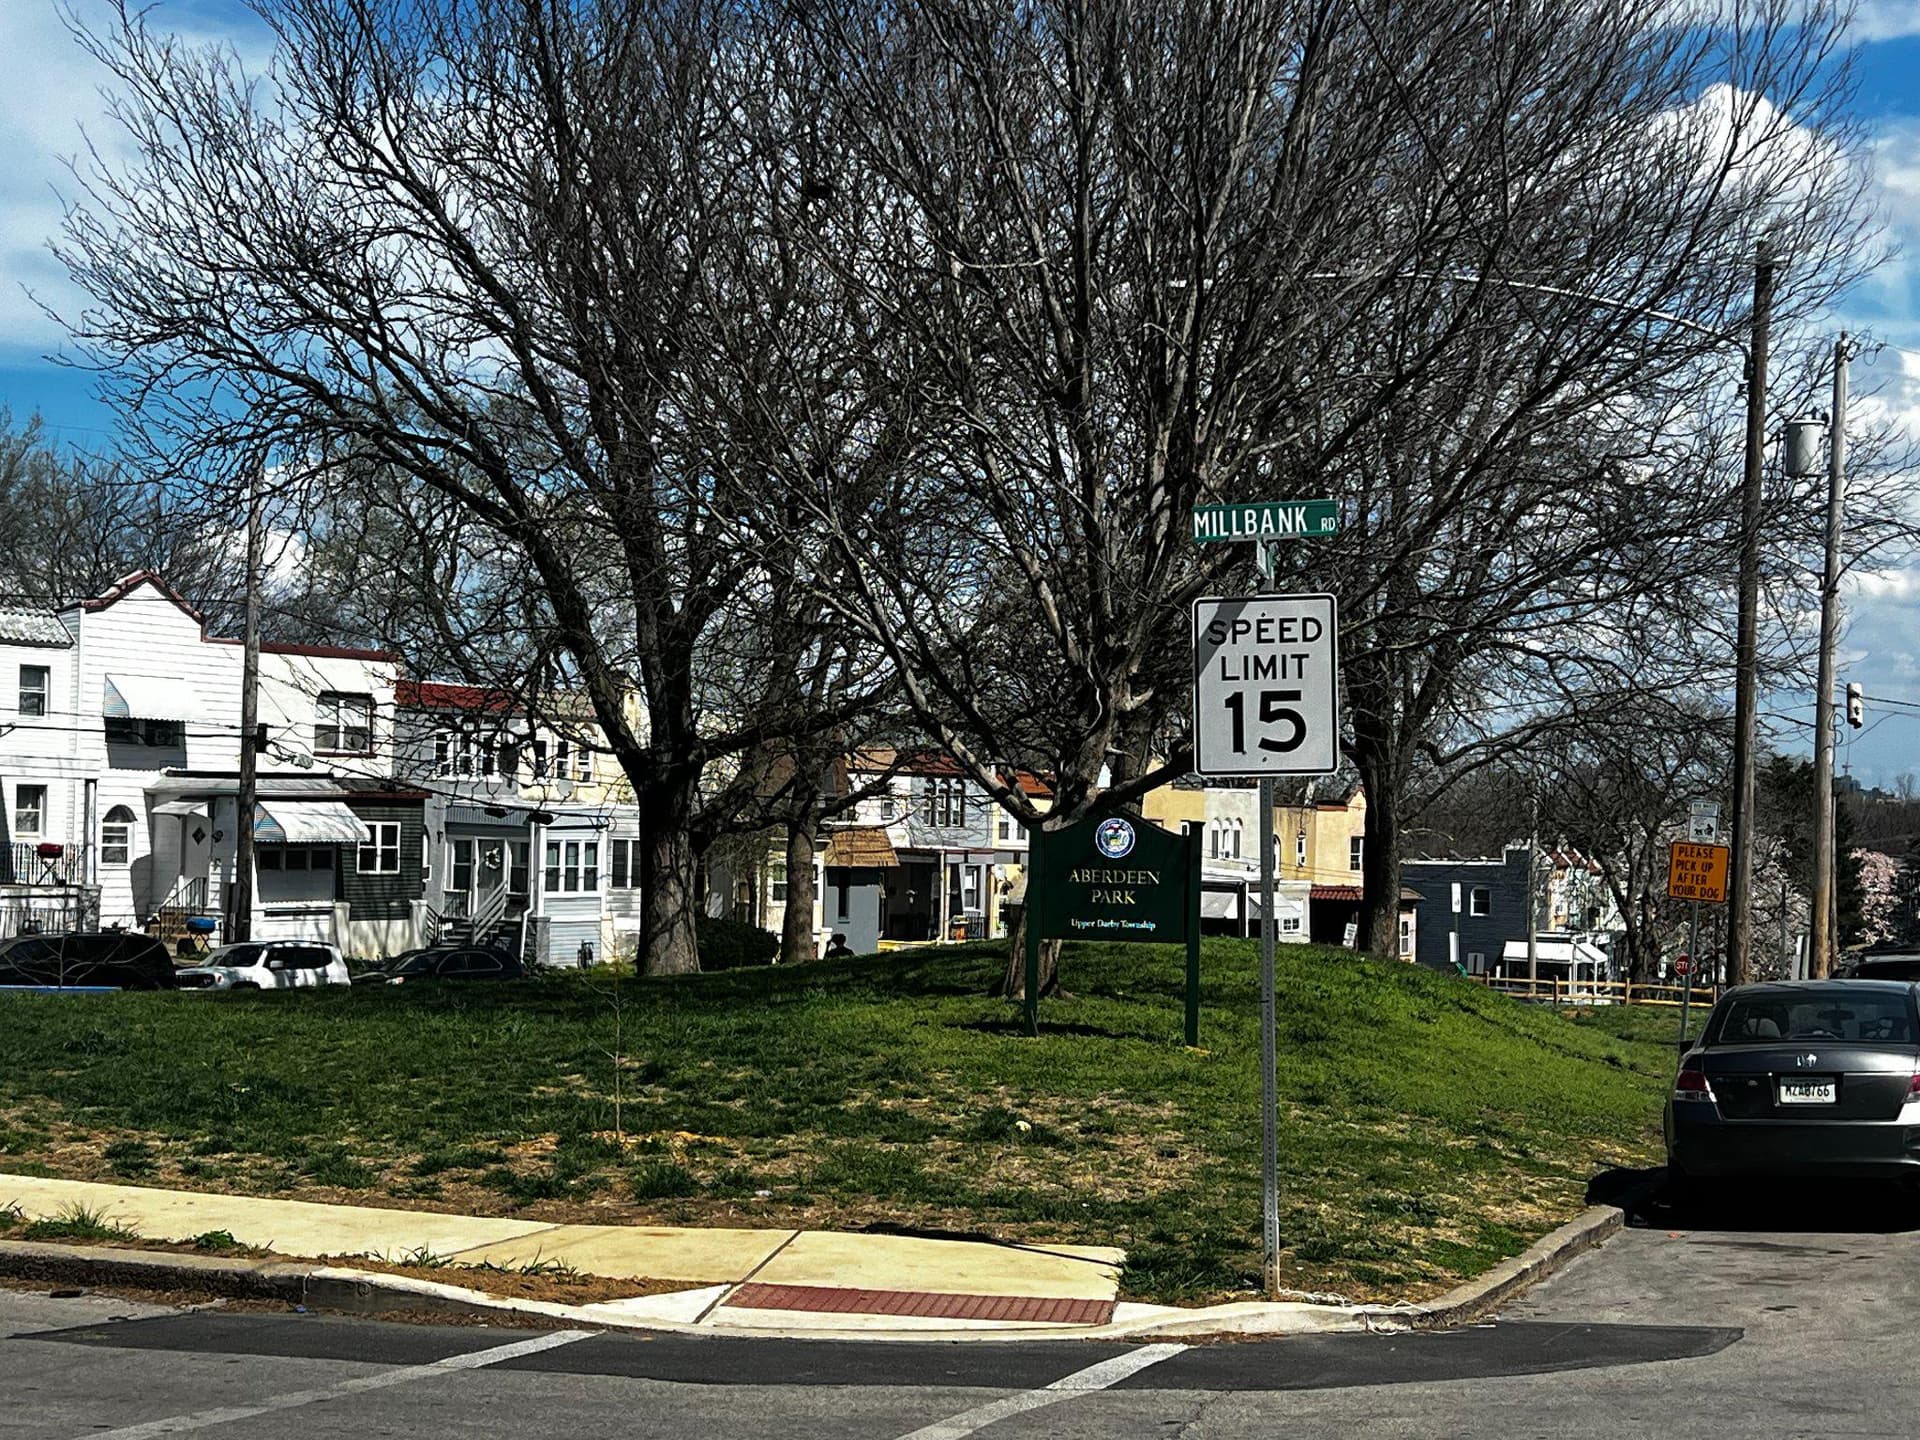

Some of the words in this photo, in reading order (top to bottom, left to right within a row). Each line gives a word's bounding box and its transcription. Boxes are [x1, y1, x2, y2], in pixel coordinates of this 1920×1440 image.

[1194, 506, 1308, 537] MILLBANK
[1321, 517, 1336, 532] RD
[1207, 617, 1322, 646] SPEED
[1221, 653, 1310, 681] LIMIT
[1224, 689, 1307, 754] 15
[1678, 846, 1714, 859] PLEASE
[1675, 859, 1697, 872] PICK
[1701, 861, 1714, 873] UP
[1068, 868, 1161, 885] ABERDEEN
[1677, 873, 1707, 885] AFTER
[1091, 889, 1136, 905] PARK
[1672, 884, 1696, 896] YOUR
[1700, 886, 1719, 899] DOG
[1071, 918, 1096, 930] Upper
[1097, 919, 1119, 931] Darby
[1120, 920, 1156, 932] Township
